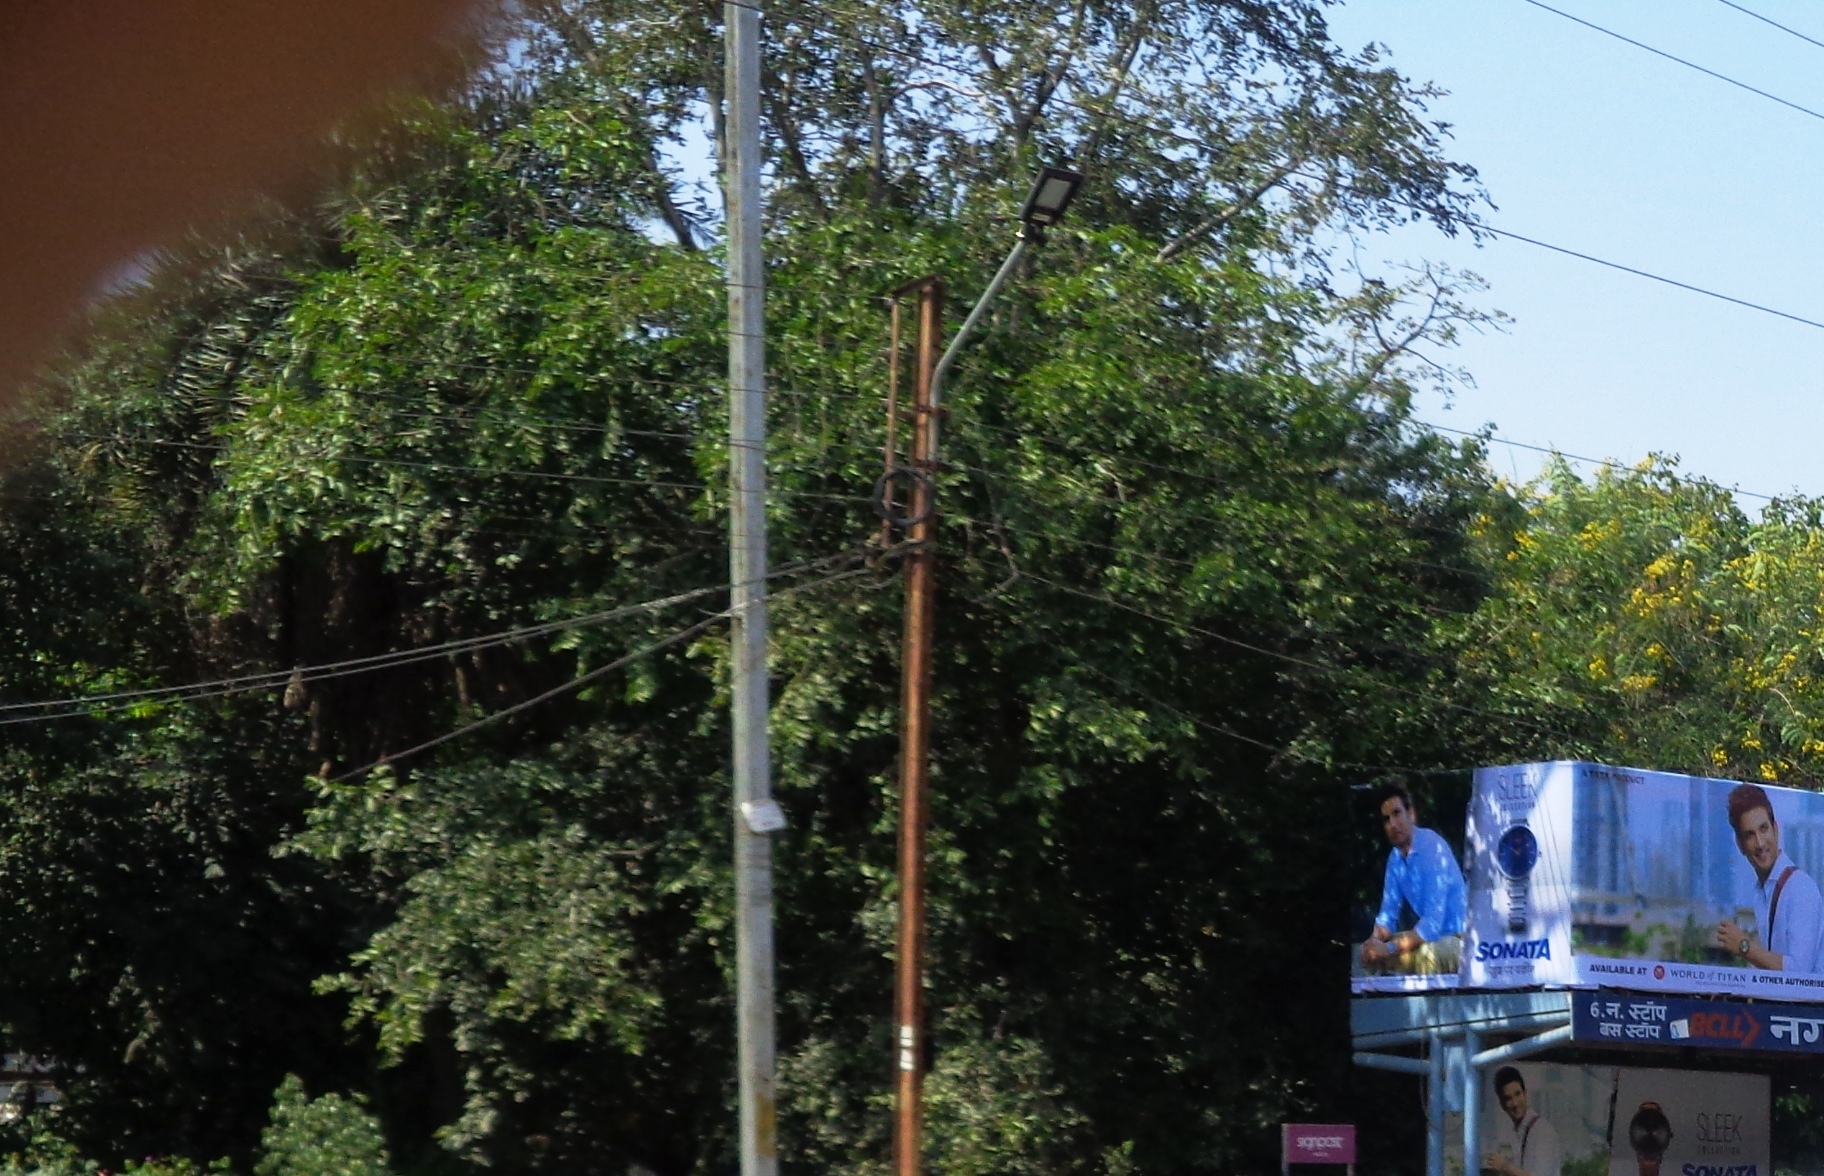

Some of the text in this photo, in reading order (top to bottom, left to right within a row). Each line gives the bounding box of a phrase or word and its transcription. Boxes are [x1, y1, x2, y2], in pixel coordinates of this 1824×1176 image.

[1476, 938, 1551, 962] SONATA
[1589, 964, 1635, 975] AVAILABLE
[1637, 967, 1647, 975] AT
[1670, 969, 1705, 980] WORLD
[1717, 972, 1746, 982] TITAN
[1752, 975, 1758, 983] &
[1759, 976, 1783, 985] OTHER
[1600, 1022, 1622, 1037] बस
[1697, 1112, 1743, 1143] SLEEK
